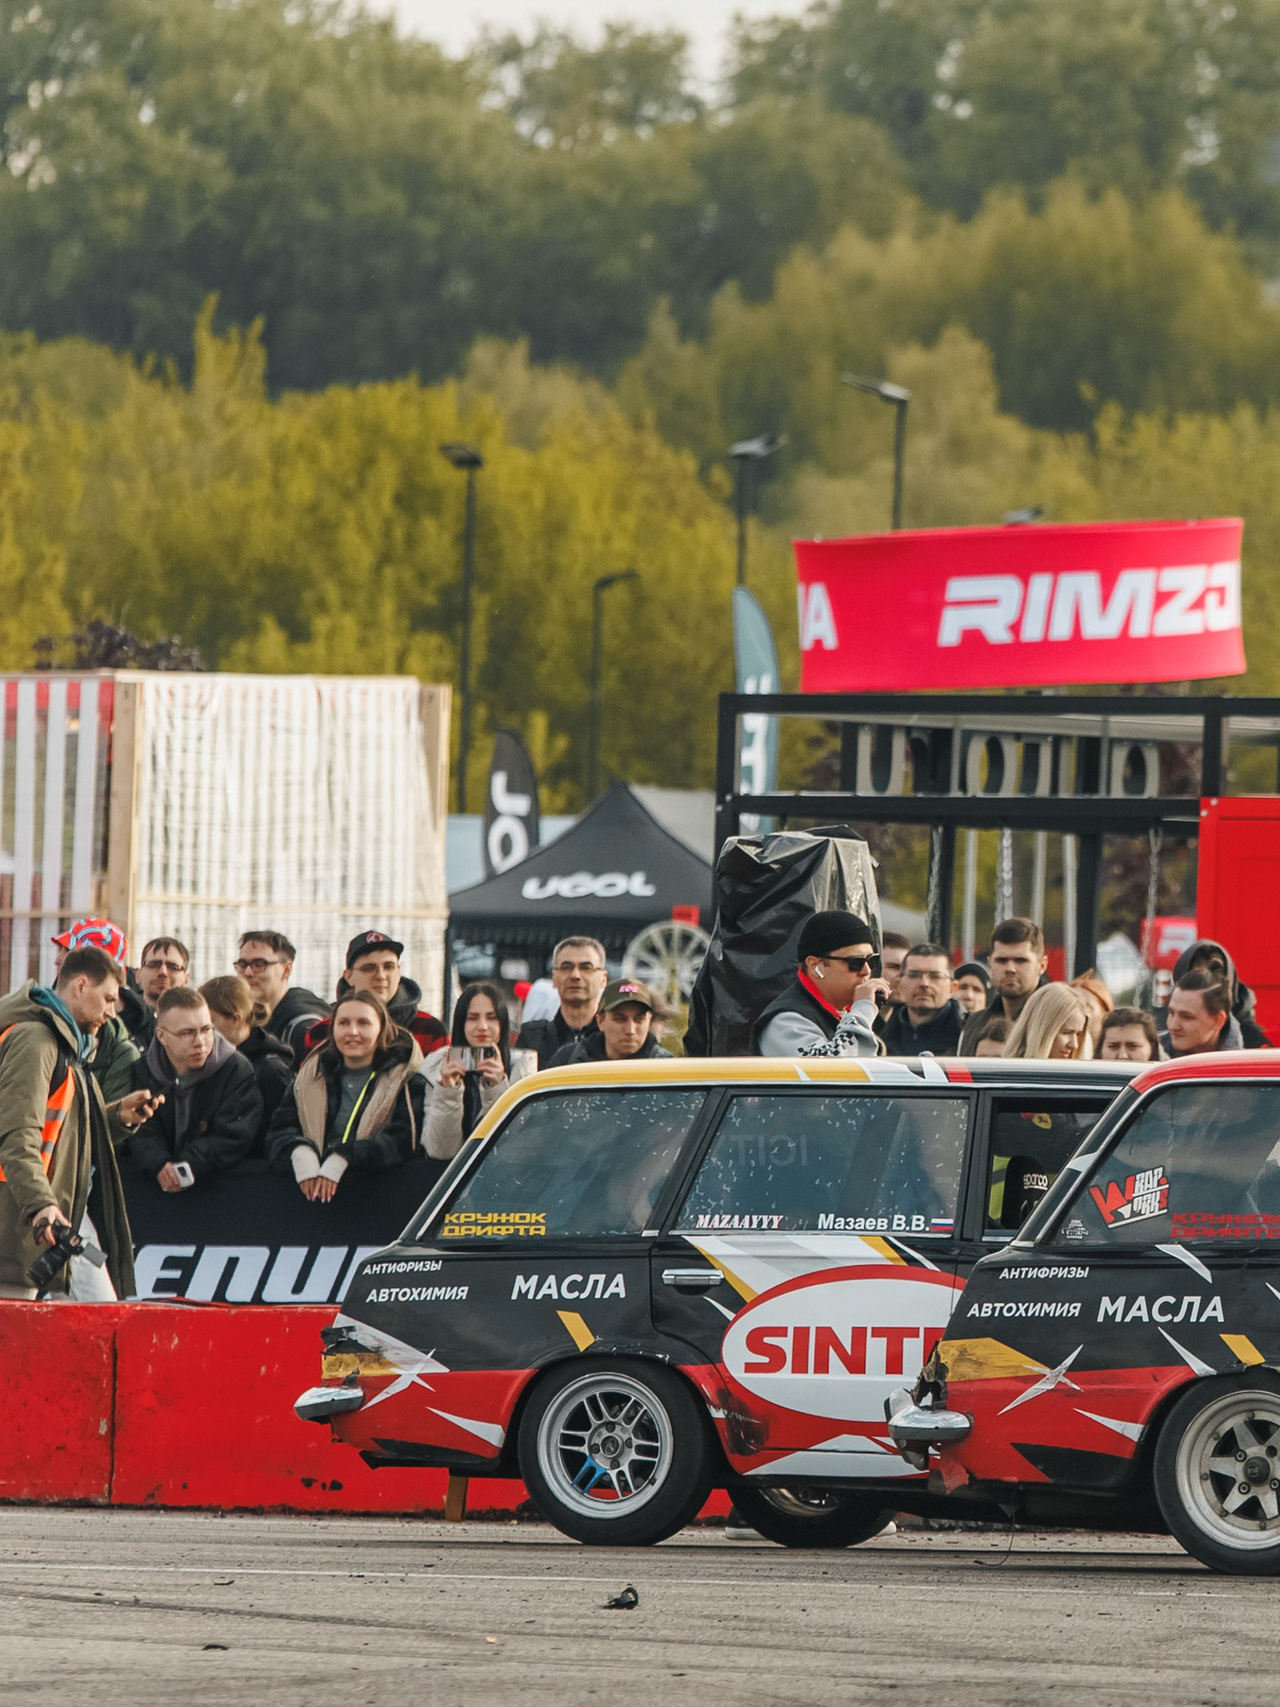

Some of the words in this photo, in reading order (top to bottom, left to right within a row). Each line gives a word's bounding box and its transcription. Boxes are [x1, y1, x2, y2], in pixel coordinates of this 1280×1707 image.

[521, 870, 657, 900] UGOL
[444, 1213, 547, 1224] КРУЖОК
[695, 1214, 784, 1229] MAZAAYYY
[818, 1213, 888, 1230] Мазаев
[892, 1214, 930, 1231] В.В.
[442, 1225, 546, 1237] ДРИФТА
[362, 1260, 443, 1276] АНТИФРИЗЫ
[999, 1266, 1090, 1280] АНТИФРИЗЫ
[366, 1286, 469, 1303] АВТОХИМИЯ
[511, 1273, 626, 1301] МАСЛА
[967, 1302, 1082, 1318] АВТОХИМИЯ
[1097, 1295, 1225, 1323] МАСЛА
[744, 1326, 947, 1375] SINT
